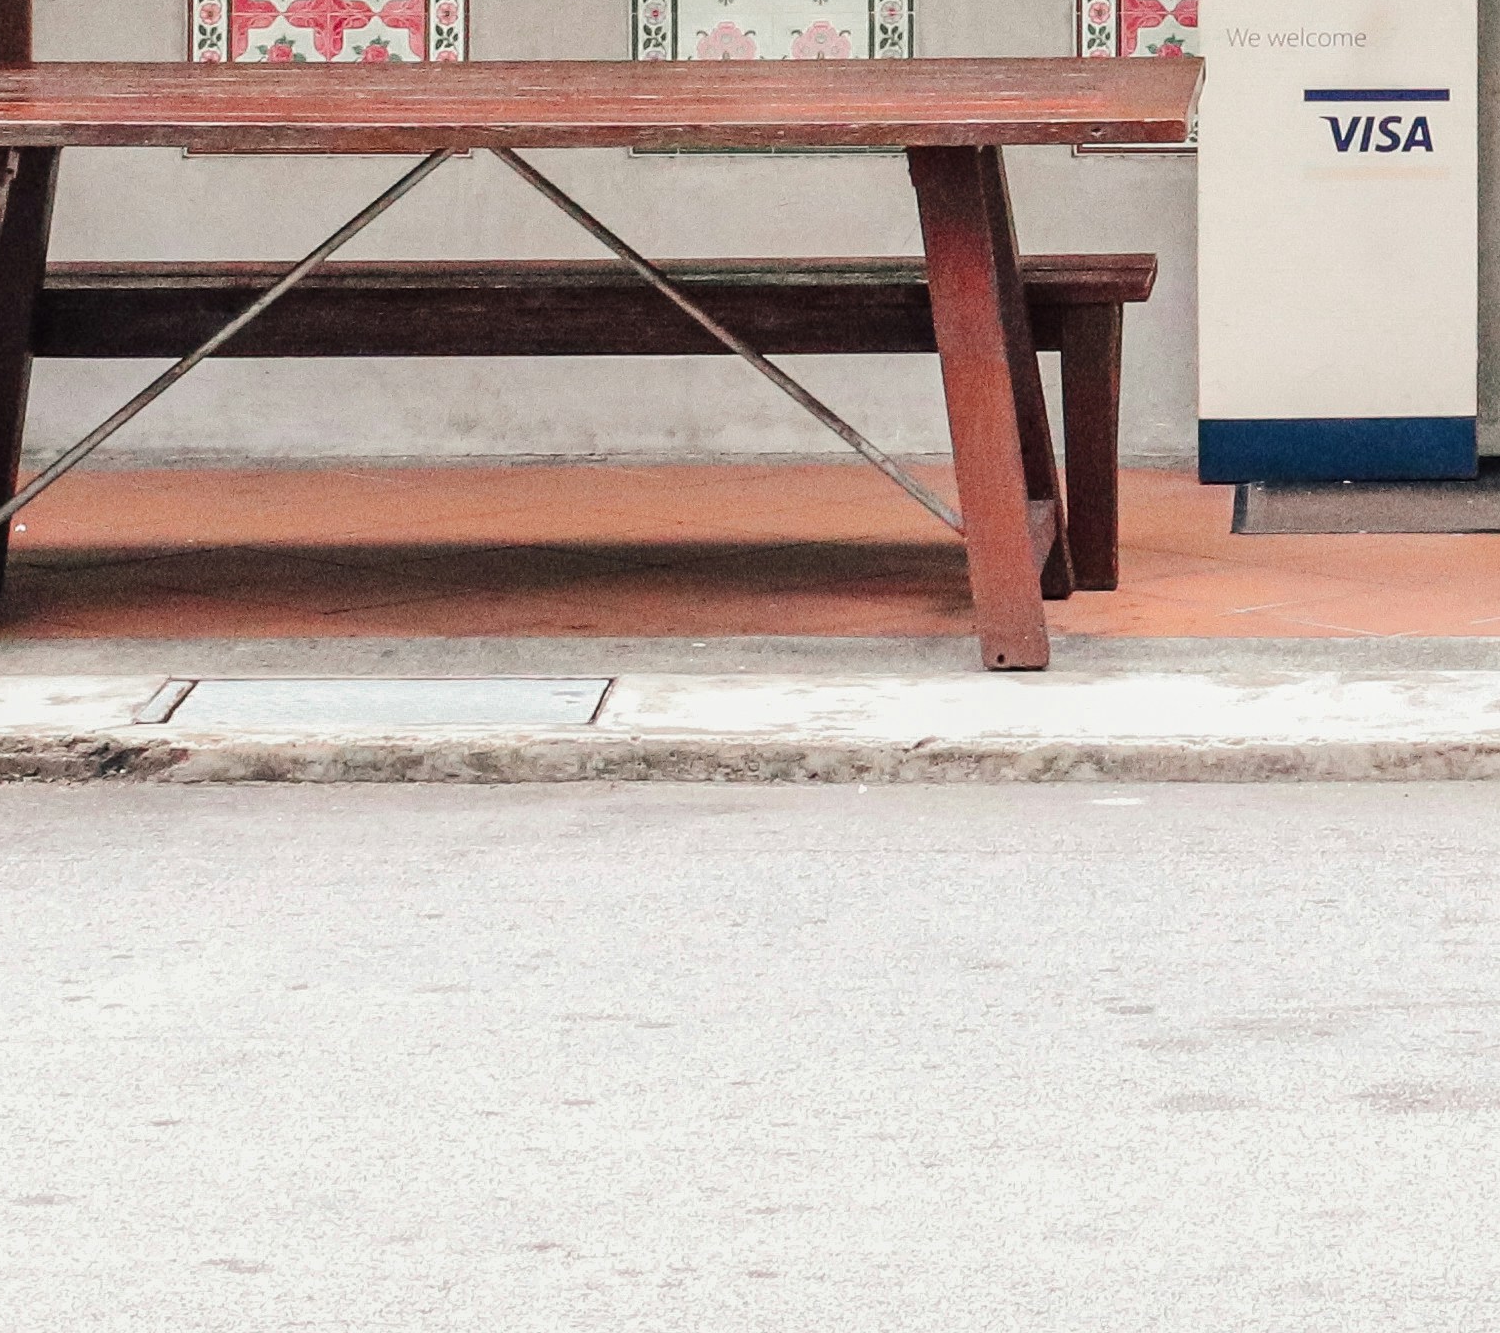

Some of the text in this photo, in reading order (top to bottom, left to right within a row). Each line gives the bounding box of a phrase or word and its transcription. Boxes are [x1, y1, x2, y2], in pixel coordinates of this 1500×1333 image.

[1225, 27, 1368, 50] We welcome
[1319, 116, 1434, 153] VISA
